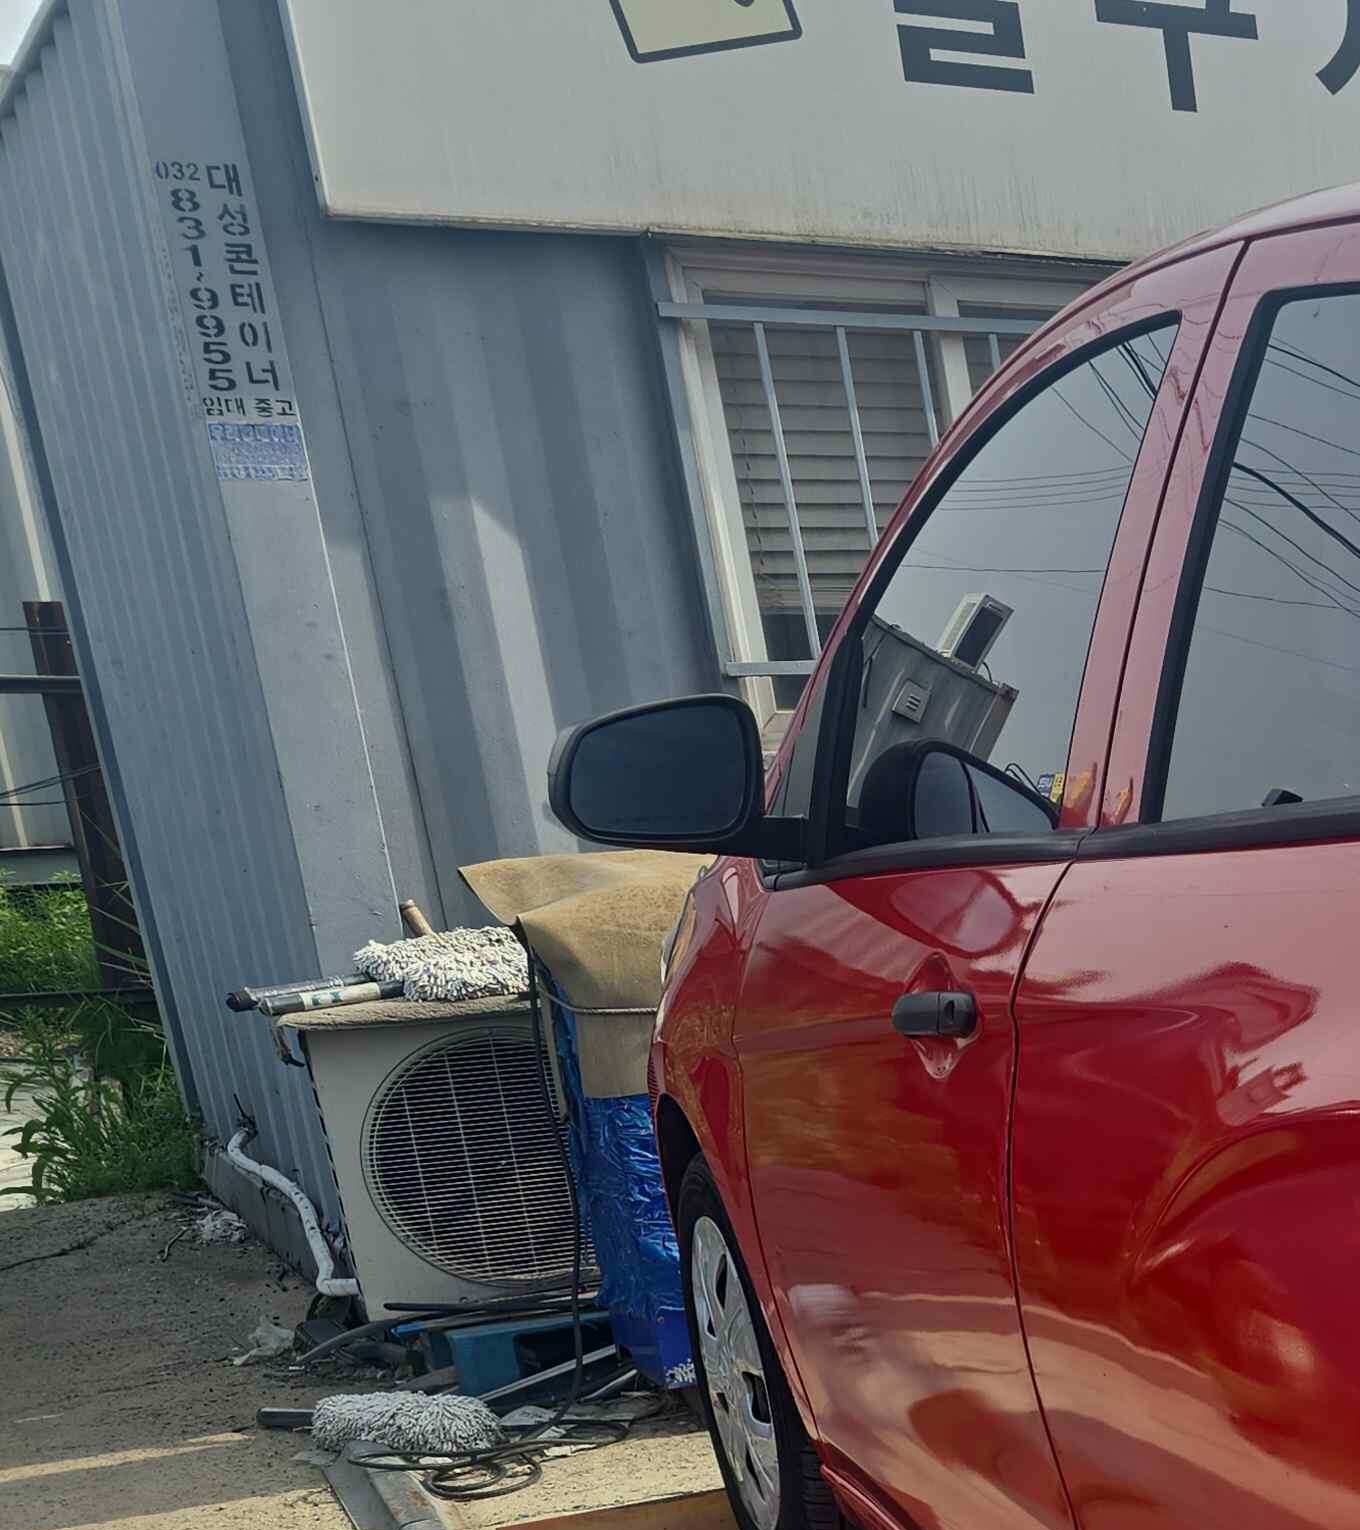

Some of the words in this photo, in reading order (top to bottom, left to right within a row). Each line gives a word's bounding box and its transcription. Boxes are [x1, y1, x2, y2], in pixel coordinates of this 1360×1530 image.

[155, 160, 201, 181] 032
[202, 396, 247, 417] 임대
[253, 397, 297, 418] 중고
